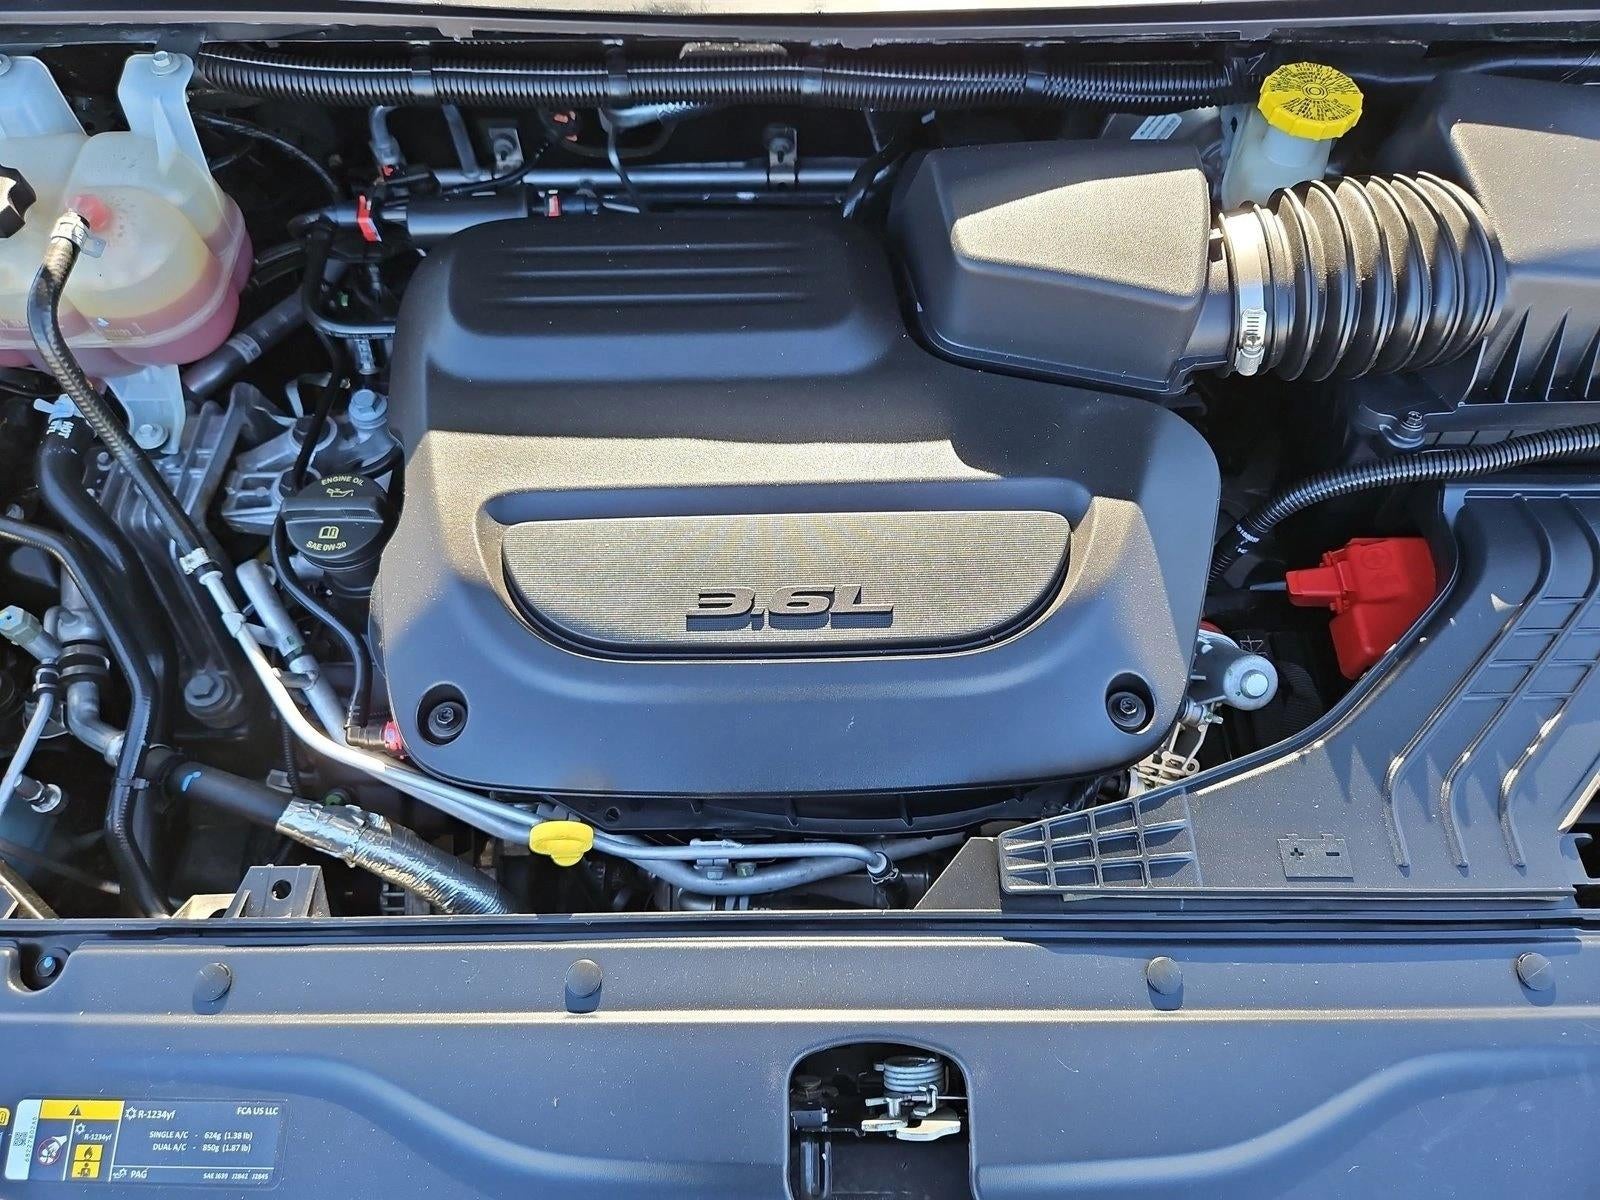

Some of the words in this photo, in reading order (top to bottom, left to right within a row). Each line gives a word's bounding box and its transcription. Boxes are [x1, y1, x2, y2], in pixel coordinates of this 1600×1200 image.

[321, 475, 352, 486] ENGINE
[352, 477, 364, 486] OIL
[306, 540, 322, 551] SAE
[322, 541, 347, 551] 0W-20
[686, 584, 894, 630] 3.6L
[138, 1109, 176, 1121] R-1234yf
[237, 1106, 251, 1115] FCA
[253, 1106, 264, 1115] US
[265, 1106, 279, 1115] LLC
[84, 1133, 112, 1142] R-1234yf
[149, 1130, 174, 1139] SINGLE
[175, 1130, 189, 1139] A/C
[204, 1131, 221, 1140] 624g
[224, 1131, 242, 1140] (1.38
[243, 1131, 253, 1140] lb)
[152, 1143, 172, 1151] DUAL
[173, 1143, 187, 1152] A/C
[202, 1143, 220, 1153] 850g
[241, 1144, 251, 1153] lb)
[131, 1170, 147, 1179] PAG
[203, 1172, 214, 1180] SAE
